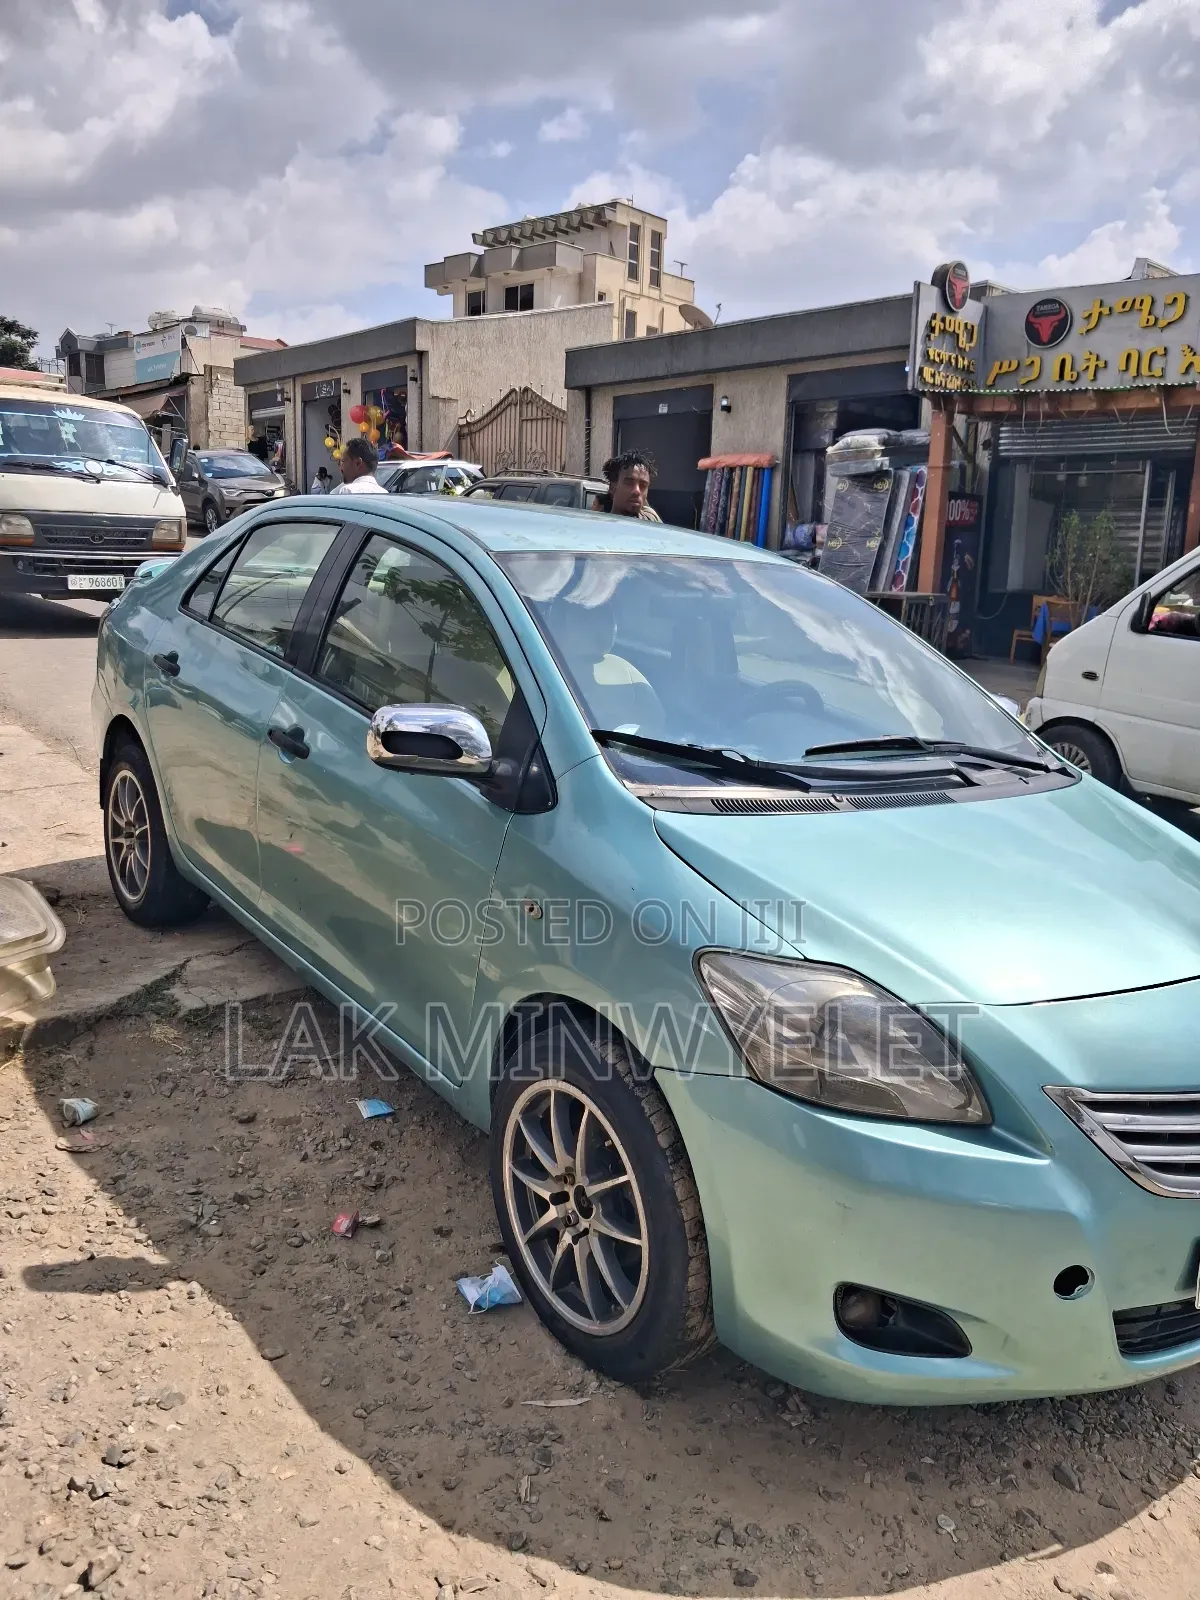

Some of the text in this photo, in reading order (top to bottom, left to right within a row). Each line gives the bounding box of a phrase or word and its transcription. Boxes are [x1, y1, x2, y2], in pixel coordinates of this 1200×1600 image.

[1079, 292, 1186, 334] ታሜጋ
[1053, 348, 1106, 382] ቤት
[1118, 346, 1166, 378] ባር
